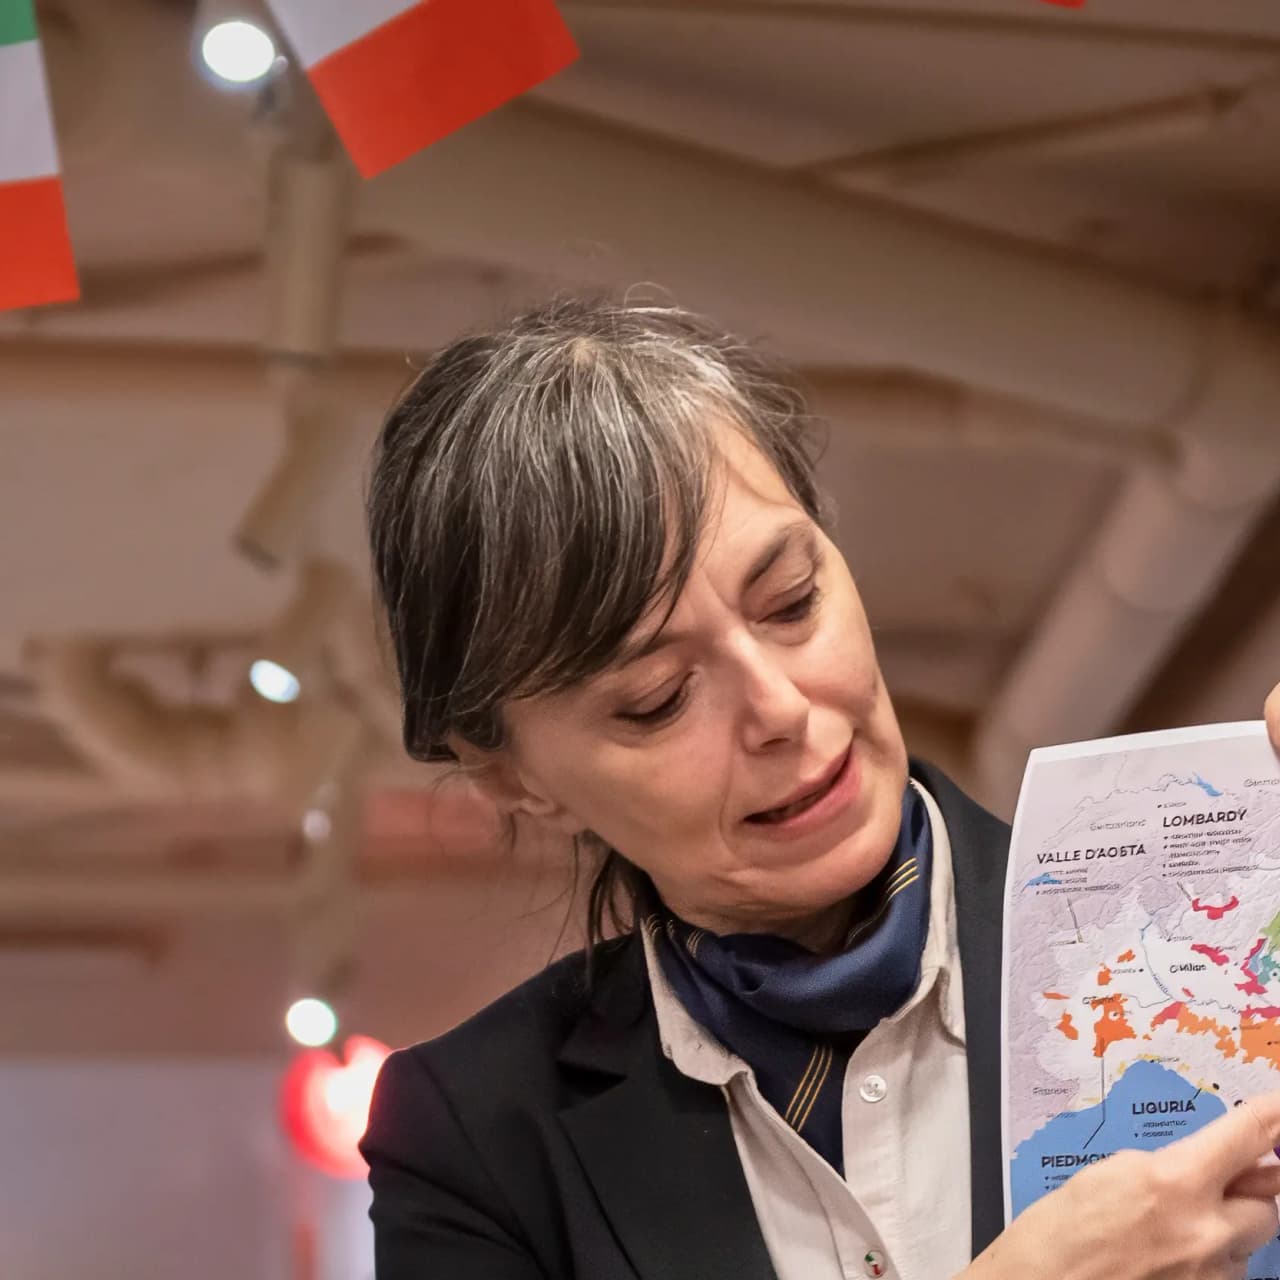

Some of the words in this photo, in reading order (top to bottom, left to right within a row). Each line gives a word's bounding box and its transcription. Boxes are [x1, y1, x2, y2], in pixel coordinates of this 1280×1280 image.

[1163, 808, 1248, 828] LOMBARDY
[1037, 850, 1081, 864] VALLE
[1132, 1100, 1197, 1115] LIGURIA
